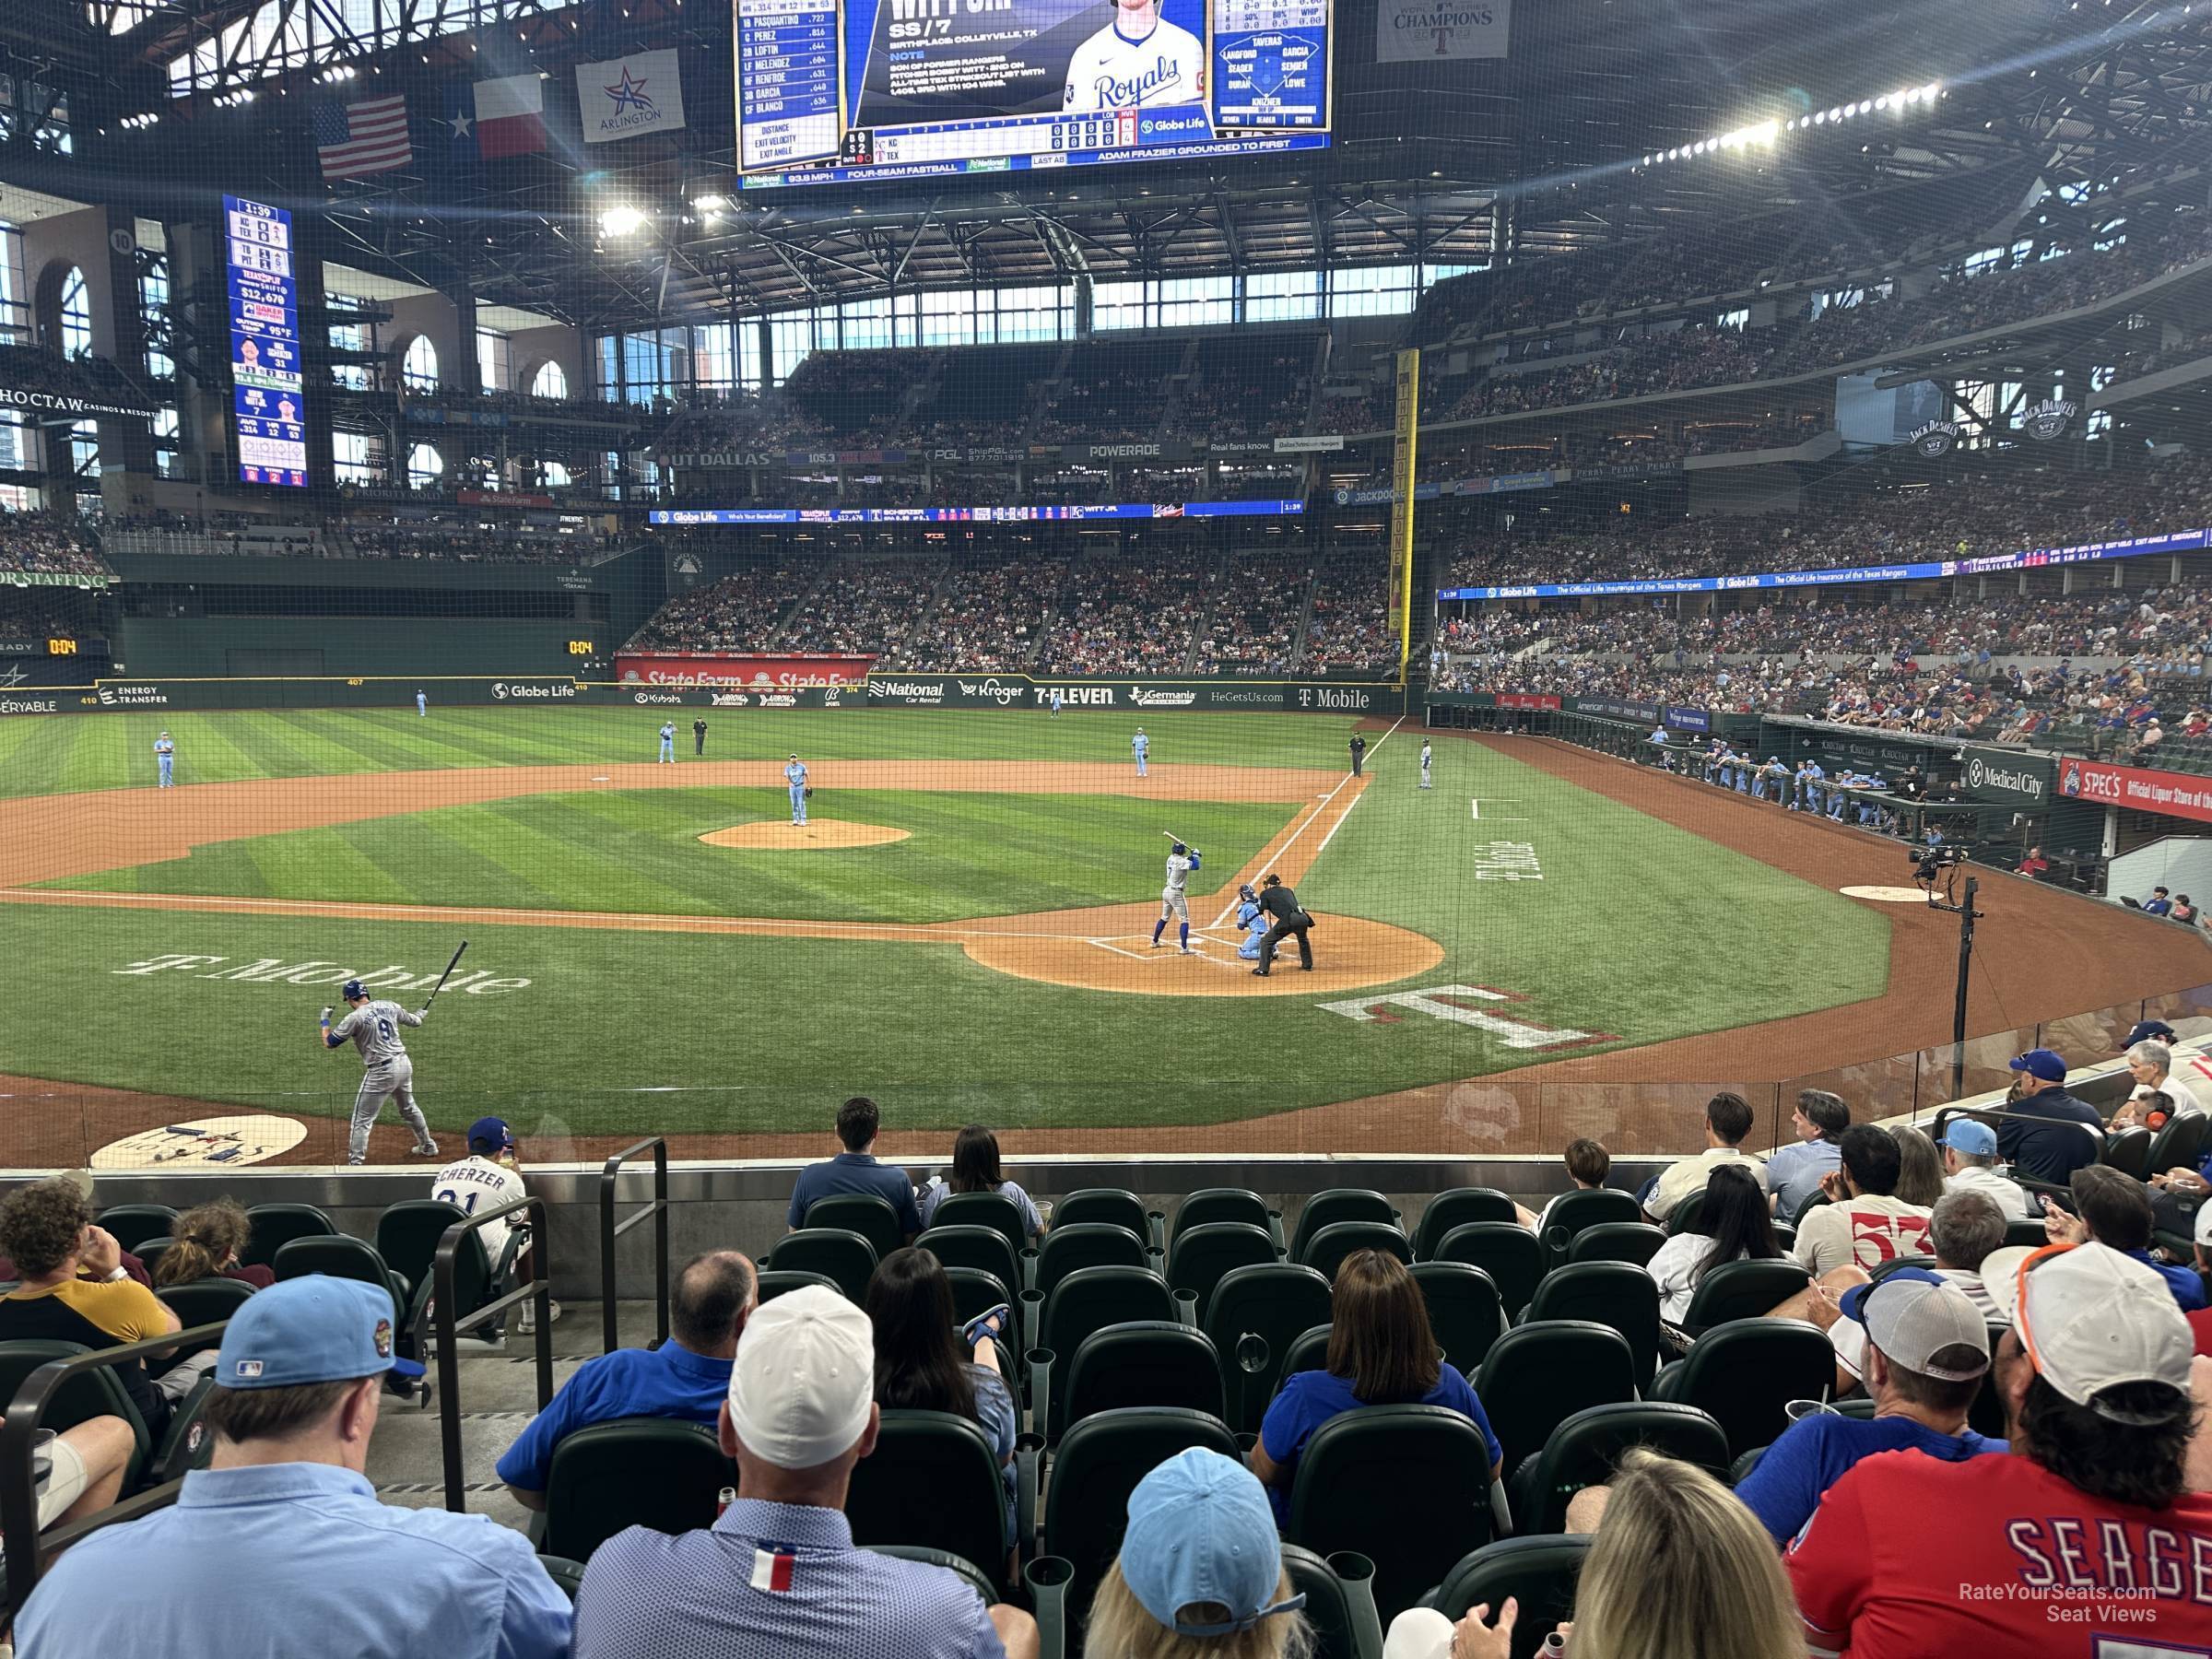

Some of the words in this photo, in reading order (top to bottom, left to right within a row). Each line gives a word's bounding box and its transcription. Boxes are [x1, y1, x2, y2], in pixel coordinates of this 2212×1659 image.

[1300, 8, 1319, 17] WHIP
[754, 15, 799, 28] PASQUANTINO
[1244, 21, 1259, 29] 0.0
[1299, 17, 1322, 25] 0.00
[1394, 10, 1493, 29] CHAMPIONS
[888, 21, 921, 38] SS
[935, 19, 952, 33] 7
[754, 30, 776, 41] PEREZ
[889, 38, 953, 49] BIRTHPLACE:
[954, 30, 1022, 44] COLLEYVILLE,
[1023, 29, 1038, 38] TX
[1253, 37, 1282, 47] TAVERAS
[755, 45, 779, 55] LOFTIN
[889, 51, 924, 61] NOTE
[1222, 49, 1257, 60] LANGFORD
[1282, 47, 1309, 57] GARCIA
[756, 58, 790, 70] MELENDEZ
[924, 60, 960, 69] FORMER
[961, 55, 1006, 65] RANGERS
[1281, 61, 1308, 71] SEMIEN
[890, 70, 928, 79] PITCHER
[961, 65, 984, 74] WITT
[1228, 64, 1253, 74] SEAGER
[756, 73, 786, 85] RENFROE
[890, 79, 928, 88] ALL-TIME
[930, 76, 947, 85] TEX
[948, 73, 998, 83] STRIKEOUT
[1000, 70, 1019, 78] LIST
[1020, 68, 1045, 76] WITH
[1095, 55, 1181, 109] Royals
[1228, 79, 1251, 89] DURAN
[1285, 78, 1306, 88] LOWE
[936, 84, 960, 92] WITH
[980, 79, 1006, 88] WINS.
[756, 88, 781, 99] GARCIA
[757, 101, 783, 113] BLANCO
[600, 110, 662, 130] ARLINGTON
[1155, 120, 1184, 131] Globe
[1186, 117, 1206, 129] Life
[761, 124, 790, 135] DISTANCE
[755, 139, 768, 148] EXIT
[770, 135, 796, 147] VELOCITY
[759, 150, 772, 159] EXIT
[773, 147, 793, 157] ANGLE
[858, 144, 865, 154] 2
[1098, 152, 1130, 161] ADAM
[1132, 148, 1176, 159] FRAZIER
[1177, 144, 1241, 155] GROUNDED
[1241, 142, 1258, 150] TO
[1259, 140, 1291, 148] FIRST
[887, 151, 899, 160] TEX
[978, 158, 1006, 166] National
[848, 168, 905, 178] FOUR-SEAM
[907, 164, 958, 175] FASTBALL
[754, 175, 781, 183] National
[789, 174, 809, 182] 93.8
[810, 173, 833, 182] MPH
[245, 203, 271, 218] 1:39
[240, 227, 252, 238] TEX
[114, 233, 130, 248] 10
[255, 303, 283, 315] BAKER
[269, 325, 292, 337] 95°F
[275, 359, 286, 368] 31
[84, 404, 119, 413] CASINOS
[2019, 402, 2041, 424] JACK
[240, 426, 258, 434] .314
[268, 429, 279, 437] 12
[1909, 426, 1929, 443] JACK
[1089, 444, 1160, 457] POWERADE
[1247, 441, 1271, 450] know.
[672, 454, 694, 466] UT
[700, 453, 771, 465] DALLAS
[809, 453, 835, 463] 105.3
[935, 450, 962, 460] PGL
[1577, 469, 1603, 478] PERRY
[1611, 465, 1639, 475] PERRY
[356, 488, 406, 499] PRIORITY
[409, 489, 441, 500] GOLD
[492, 496, 512, 504] State
[512, 497, 531, 505] Farm
[673, 512, 699, 522] Globe
[700, 512, 717, 521] Life
[22, 572, 105, 588] STAFFING
[1727, 579, 1747, 587] Globe
[1747, 576, 1759, 585] Life
[1806, 574, 1816, 582] Life
[1845, 571, 1852, 580] of
[1853, 571, 1862, 579] the
[1864, 570, 1880, 578] Texas
[1882, 569, 1907, 578] Rangers
[1500, 588, 1521, 597] Globe
[1523, 587, 1537, 595] Life
[49, 639, 76, 654] 0:04
[569, 641, 592, 654] 0:04
[649, 670, 694, 688] State
[697, 671, 741, 688] Farm
[780, 672, 827, 688] State
[118, 687, 158, 695] ENERGY
[512, 686, 549, 697] Globe
[552, 685, 574, 697] Life
[886, 682, 944, 698] National
[980, 678, 1023, 705] Kroger
[1148, 690, 1195, 700] Germania
[119, 696, 168, 704] TRANSFER
[649, 693, 682, 704] Kubota
[721, 694, 743, 702] ARROW
[768, 695, 791, 703] ARROW
[1210, 691, 1284, 703] HeGetsUs.com
[1317, 689, 1370, 709] Mobile
[1577, 701, 1604, 712] American
[1983, 767, 2021, 792] Medical
[2021, 774, 2043, 800] City
[2084, 771, 2121, 798] SPEC'S
[2127, 780, 2150, 798] Official
[2151, 783, 2172, 805] Liquor
[2173, 787, 2193, 806] Store
[2194, 791, 2202, 807] of
[194, 958, 532, 995] Mobile
[378, 1018, 392, 1041] 9
[435, 1168, 505, 1191] SCHERZER
[1851, 1212, 1934, 1269] 53
